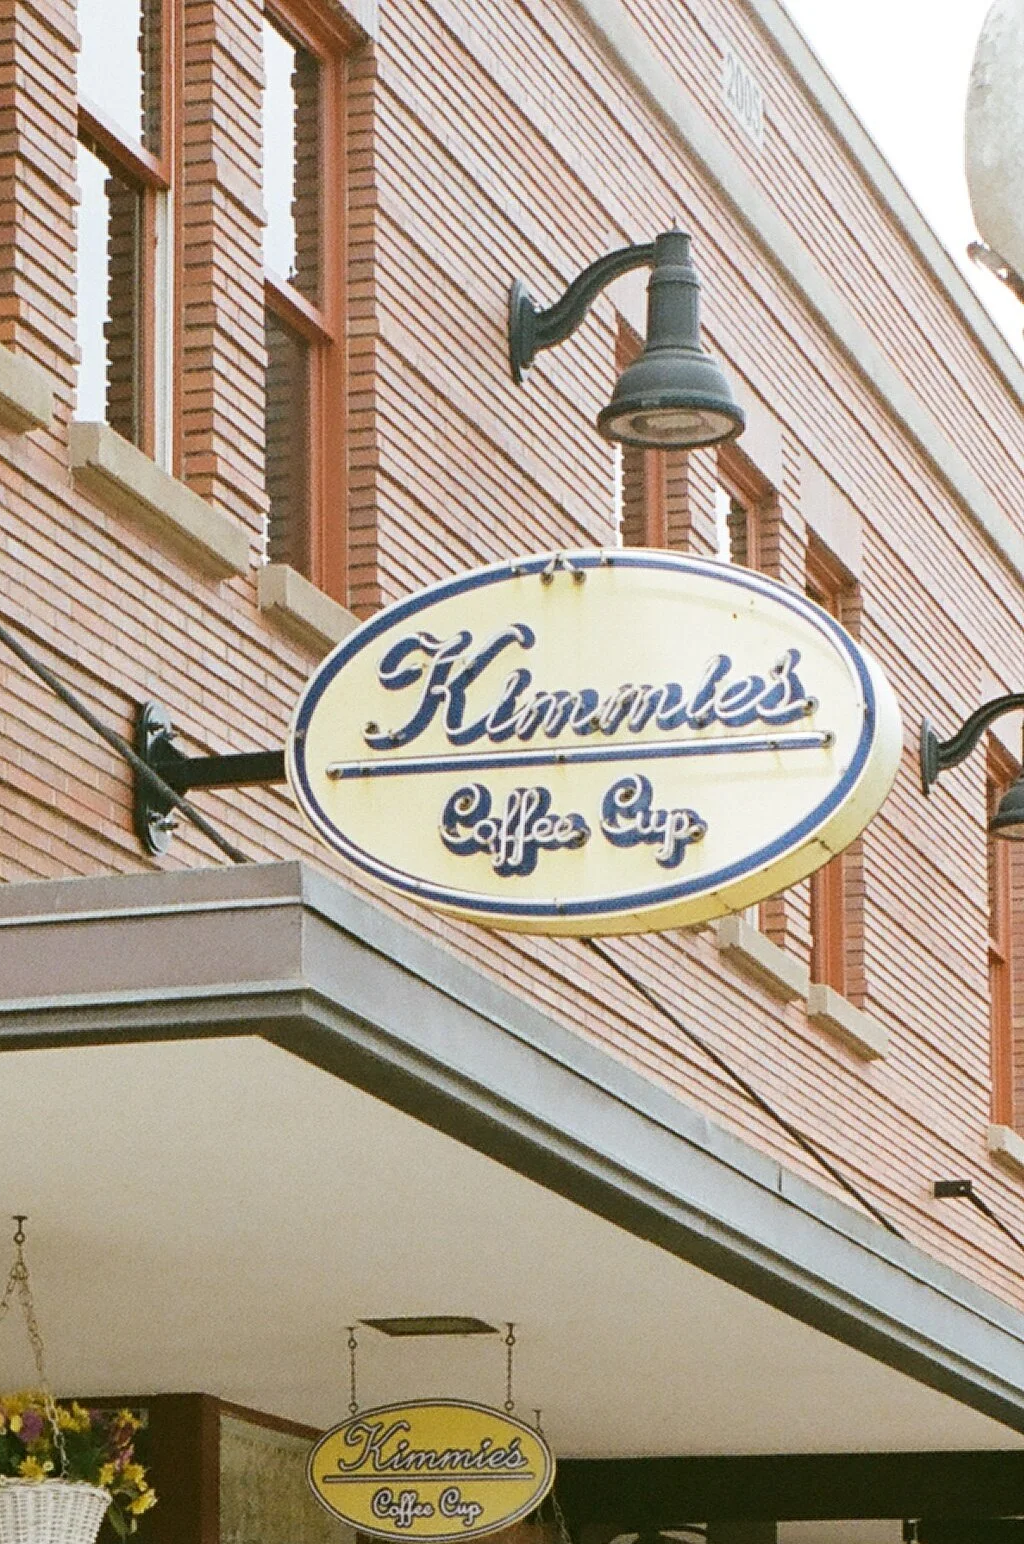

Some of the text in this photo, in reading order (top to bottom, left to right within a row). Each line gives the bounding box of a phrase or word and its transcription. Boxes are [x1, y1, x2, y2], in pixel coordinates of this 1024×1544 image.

[364, 623, 819, 750] Kimmie's
[439, 773, 708, 878] Coffee Cup
[337, 1419, 528, 1472] Kimmie's
[371, 1486, 483, 1528] Coffee Cup
